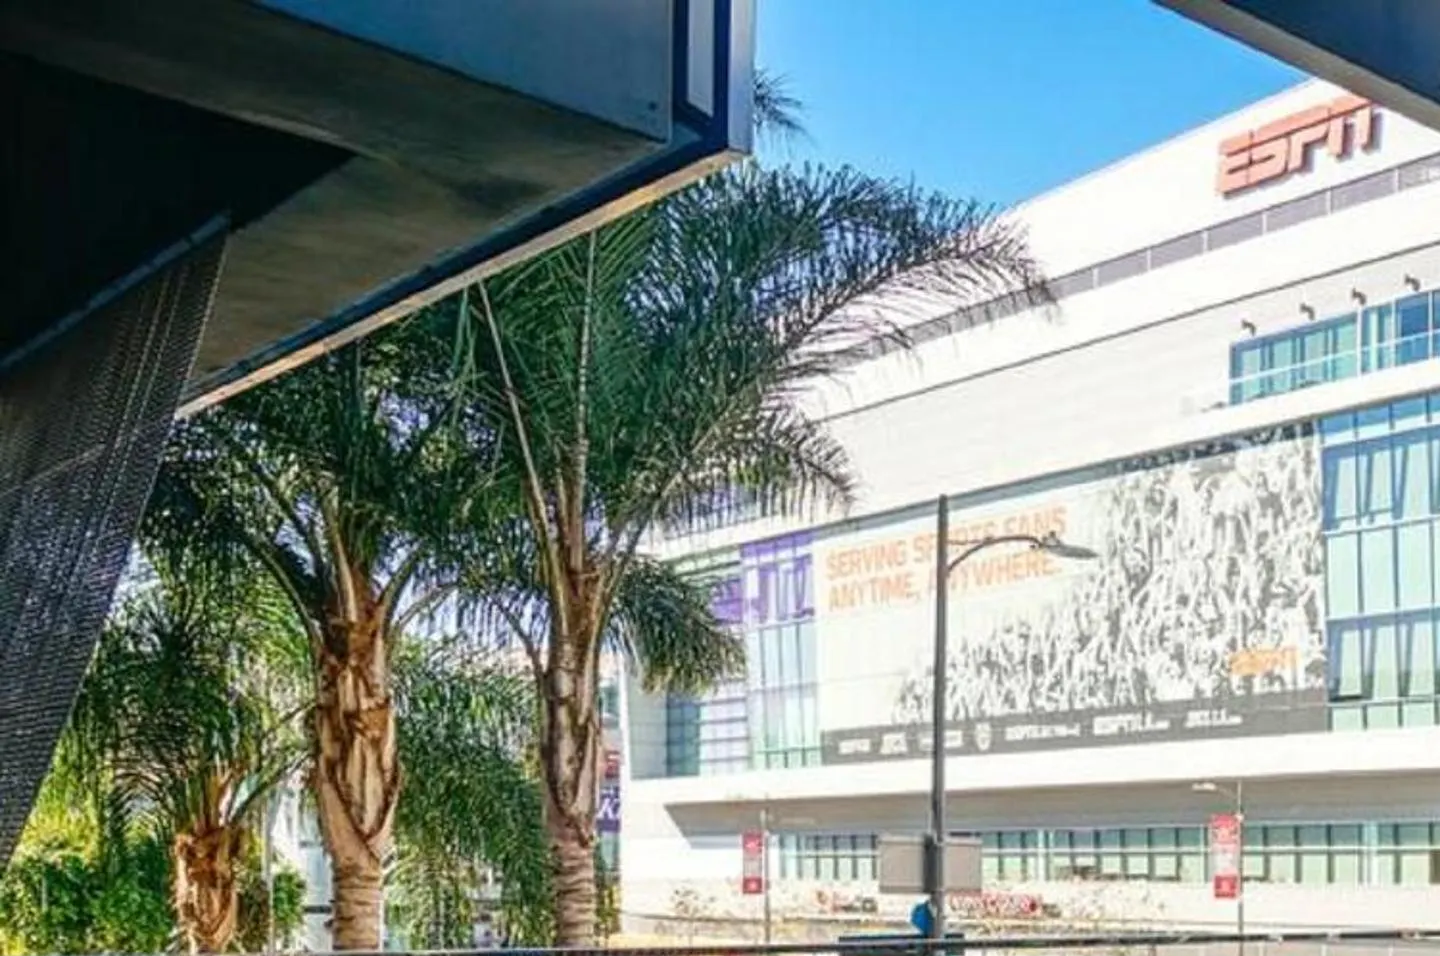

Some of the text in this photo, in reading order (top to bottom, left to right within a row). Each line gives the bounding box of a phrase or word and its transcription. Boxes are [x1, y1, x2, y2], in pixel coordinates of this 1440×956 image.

[1218, 97, 1372, 195] ESPN
[826, 540, 907, 580] SERVING
[828, 571, 922, 612] ANYTIME,
